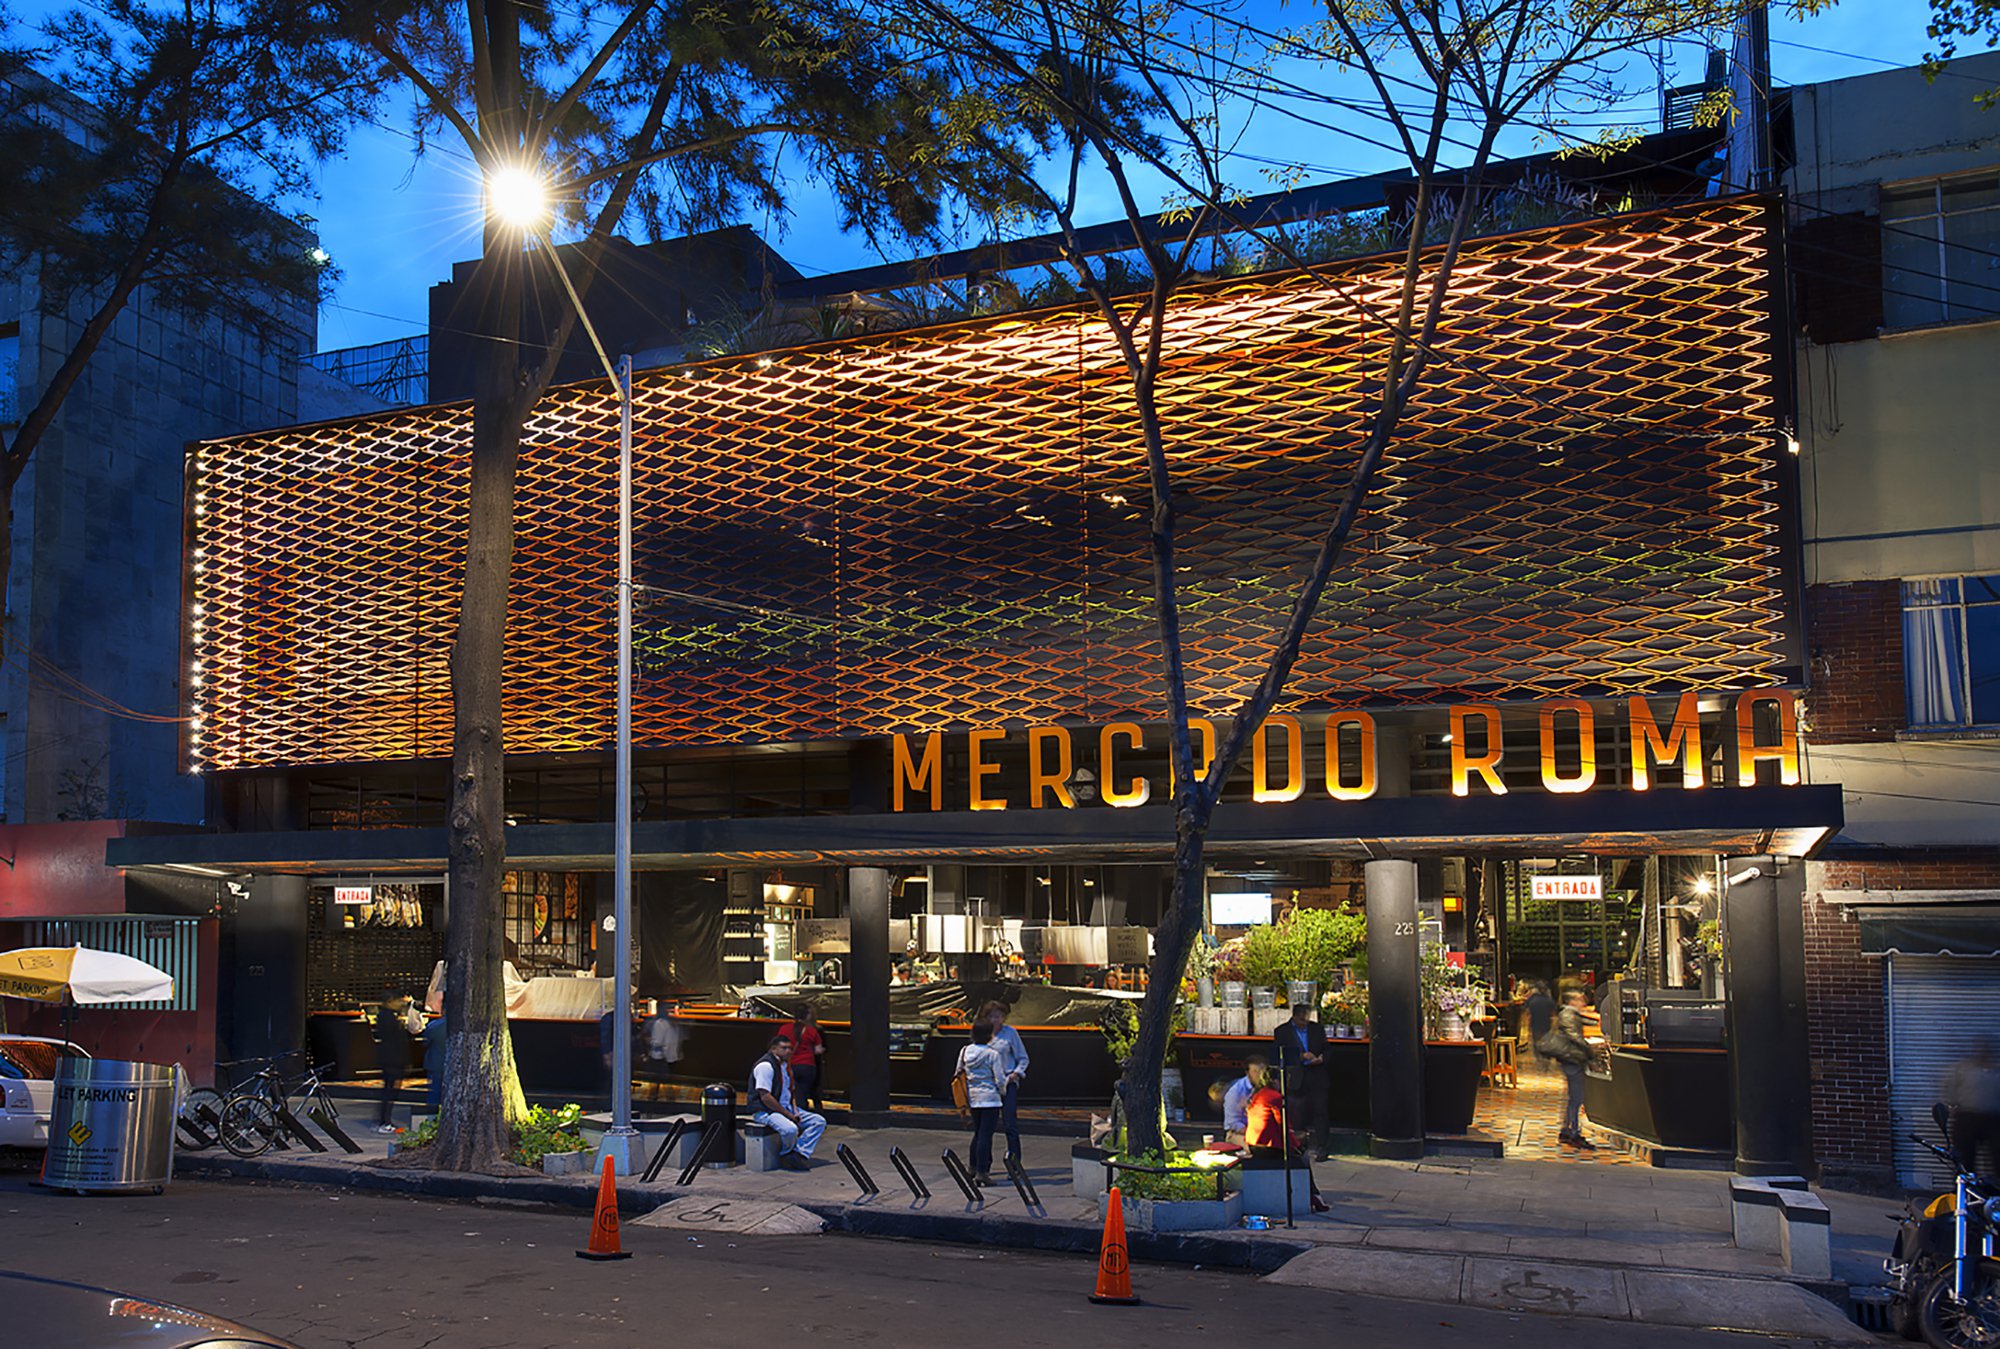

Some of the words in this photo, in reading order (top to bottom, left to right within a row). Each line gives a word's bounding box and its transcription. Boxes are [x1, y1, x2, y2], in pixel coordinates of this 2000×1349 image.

[1450, 689, 1800, 797] ROMA
[1536, 881, 1596, 895] ENTRADA
[337, 890, 369, 901] ENTRADA
[78, 1088, 136, 1102] PARKING
